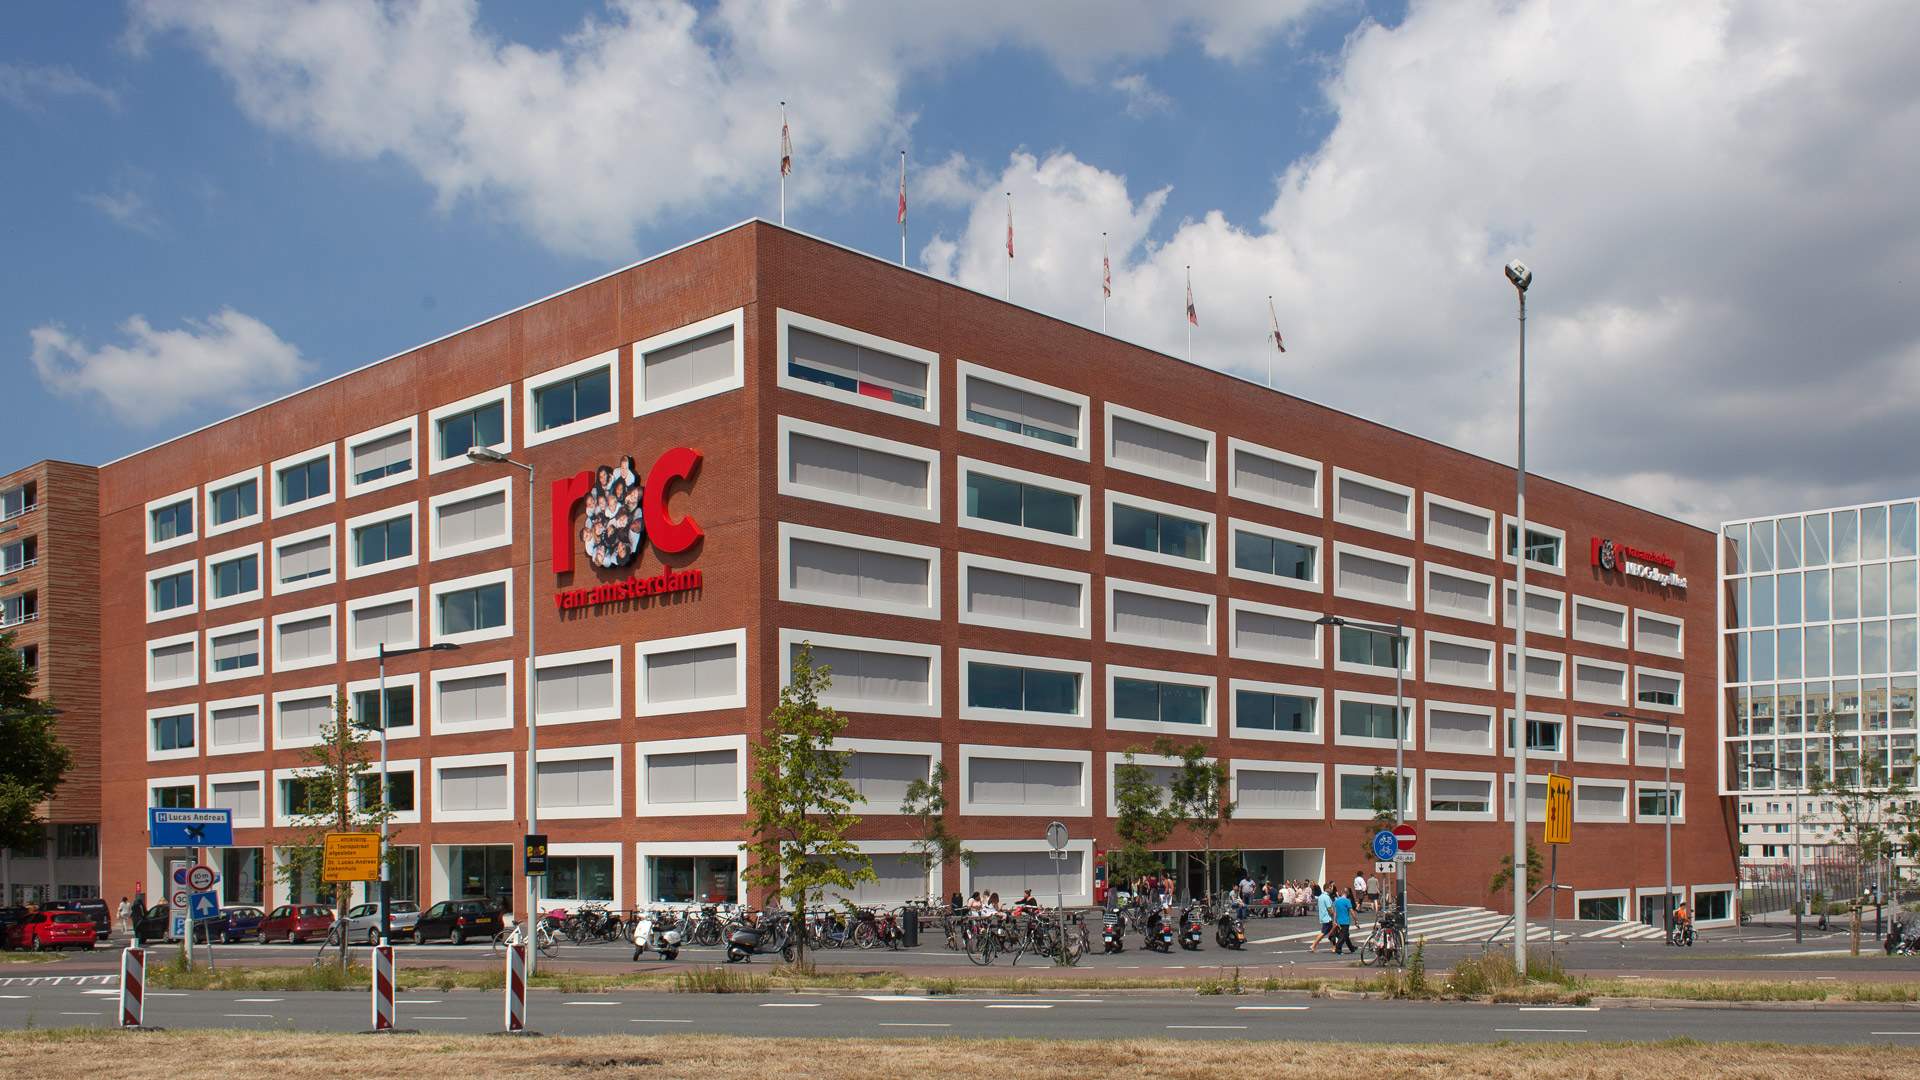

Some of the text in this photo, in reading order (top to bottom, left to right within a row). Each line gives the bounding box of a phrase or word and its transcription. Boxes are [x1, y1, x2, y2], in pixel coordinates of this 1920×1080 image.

[588, 565, 703, 604] amsterdam
[169, 813, 192, 821] Lucas
[193, 813, 225, 821] Andreas
